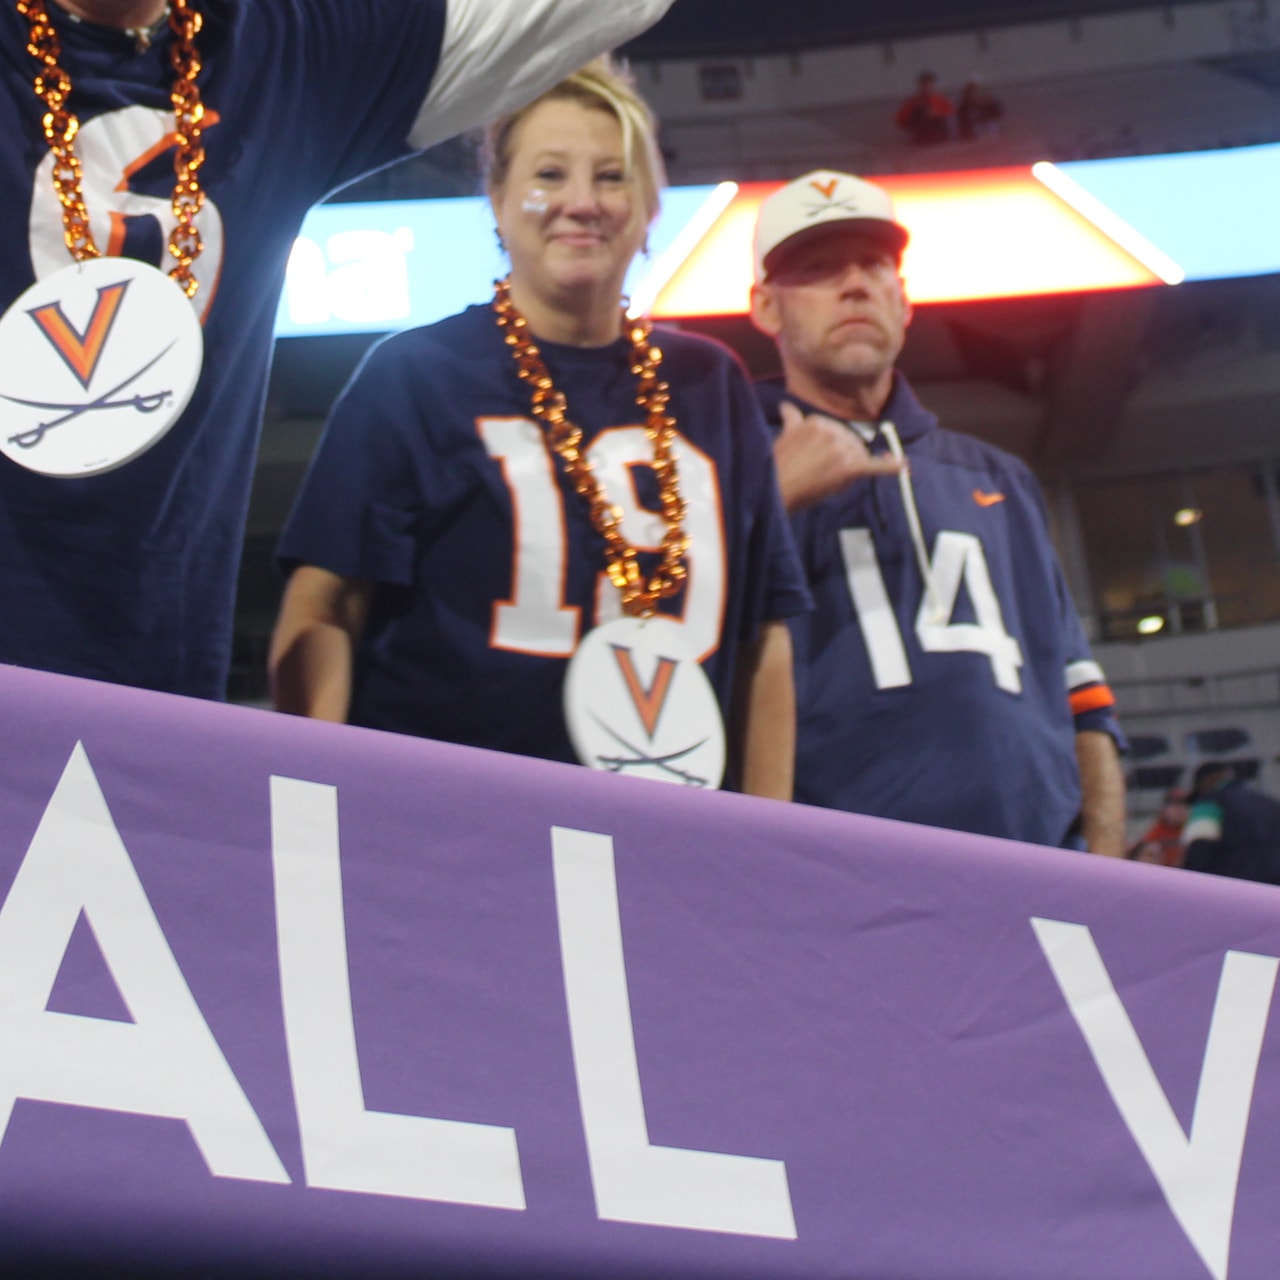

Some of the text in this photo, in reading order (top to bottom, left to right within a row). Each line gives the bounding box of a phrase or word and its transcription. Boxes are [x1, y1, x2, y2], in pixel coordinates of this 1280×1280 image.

[26, 277, 135, 391] V
[475, 414, 727, 665] 19
[837, 527, 1024, 696] 14
[607, 641, 681, 745] V
